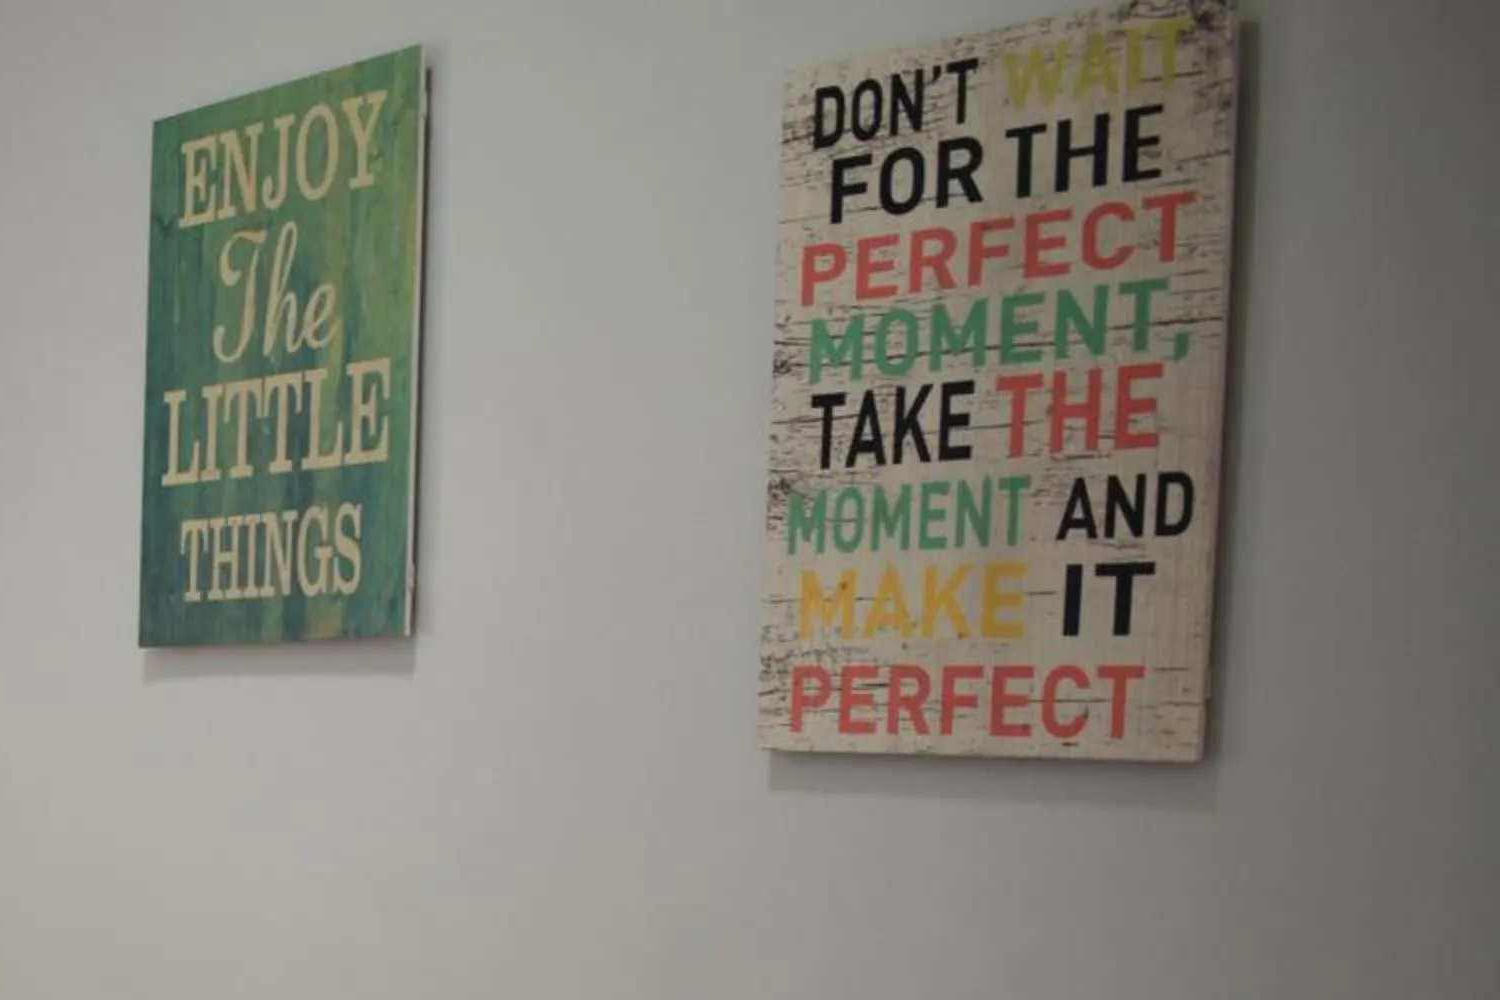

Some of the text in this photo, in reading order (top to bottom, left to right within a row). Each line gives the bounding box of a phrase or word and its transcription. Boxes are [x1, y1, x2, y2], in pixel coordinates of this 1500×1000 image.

[813, 17, 1190, 150] DON'T WAIT
[180, 91, 386, 227] ENJOY
[830, 104, 1164, 224] FOR THE
[213, 221, 336, 362] The
[801, 190, 1197, 307] PERFECT
[808, 277, 1193, 385] MOMENT,
[161, 357, 391, 487] LITTLE
[811, 363, 1164, 470] TAKE THE
[180, 501, 363, 602] THINGS
[786, 471, 1194, 555] MOMENT AND
[800, 561, 1156, 642] MAKE IT
[789, 664, 1146, 740] PERFECT
